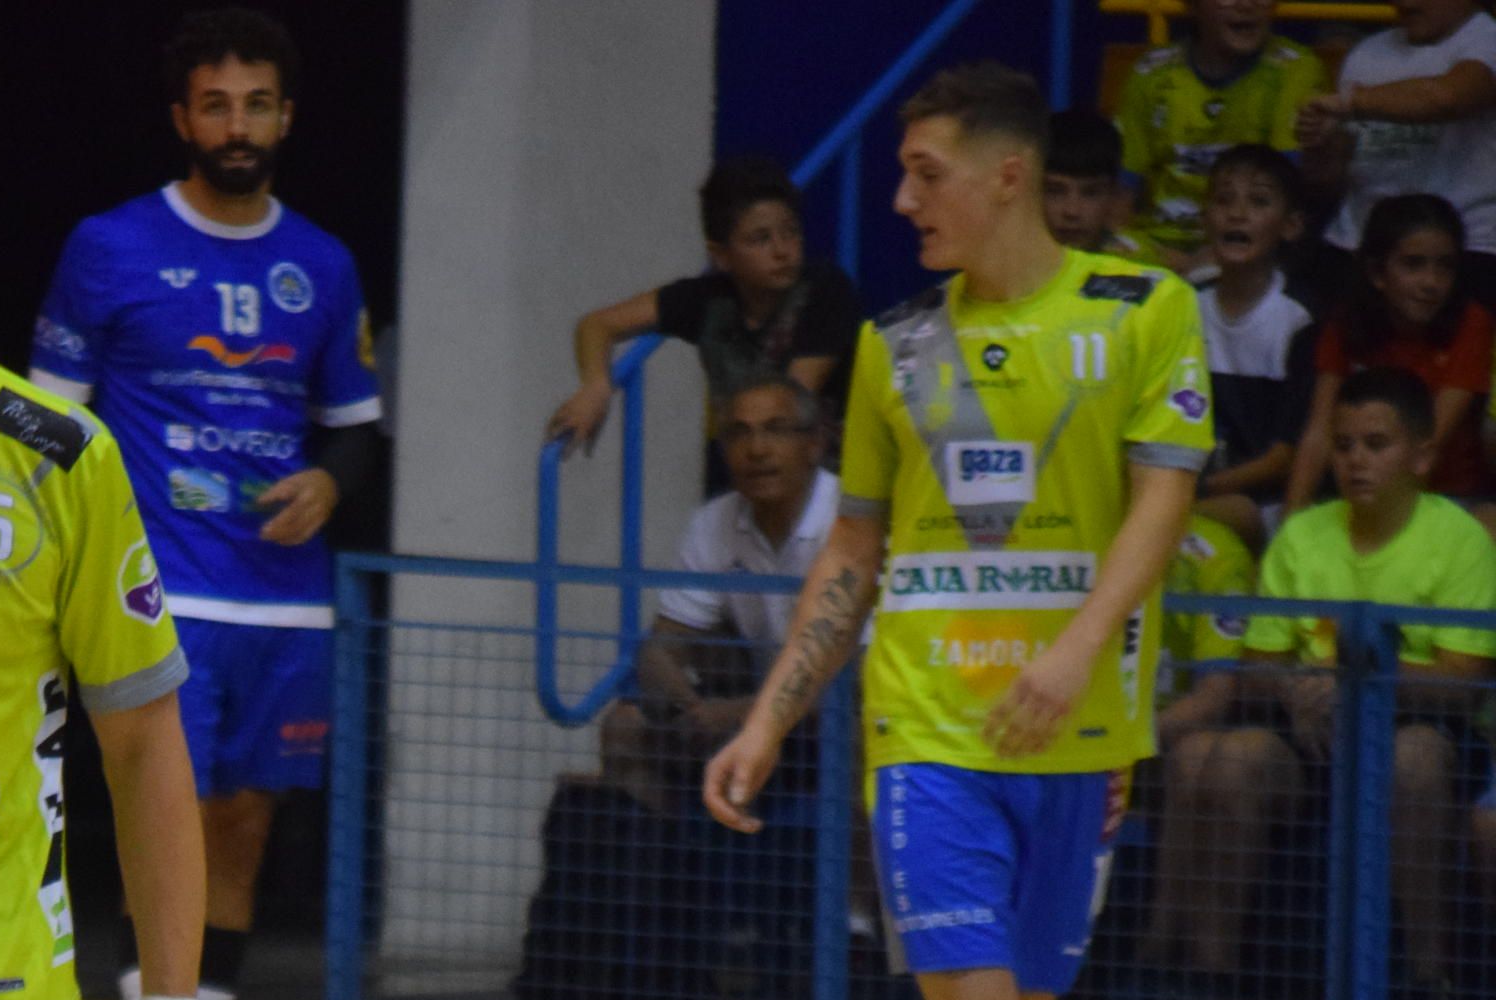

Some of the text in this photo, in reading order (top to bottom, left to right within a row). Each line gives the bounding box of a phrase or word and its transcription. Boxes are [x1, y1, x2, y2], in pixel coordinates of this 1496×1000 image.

[214, 282, 261, 336] 13
[1070, 332, 1106, 380] 11
[960, 449, 1025, 482] gaza
[890, 565, 968, 595] CAJA
